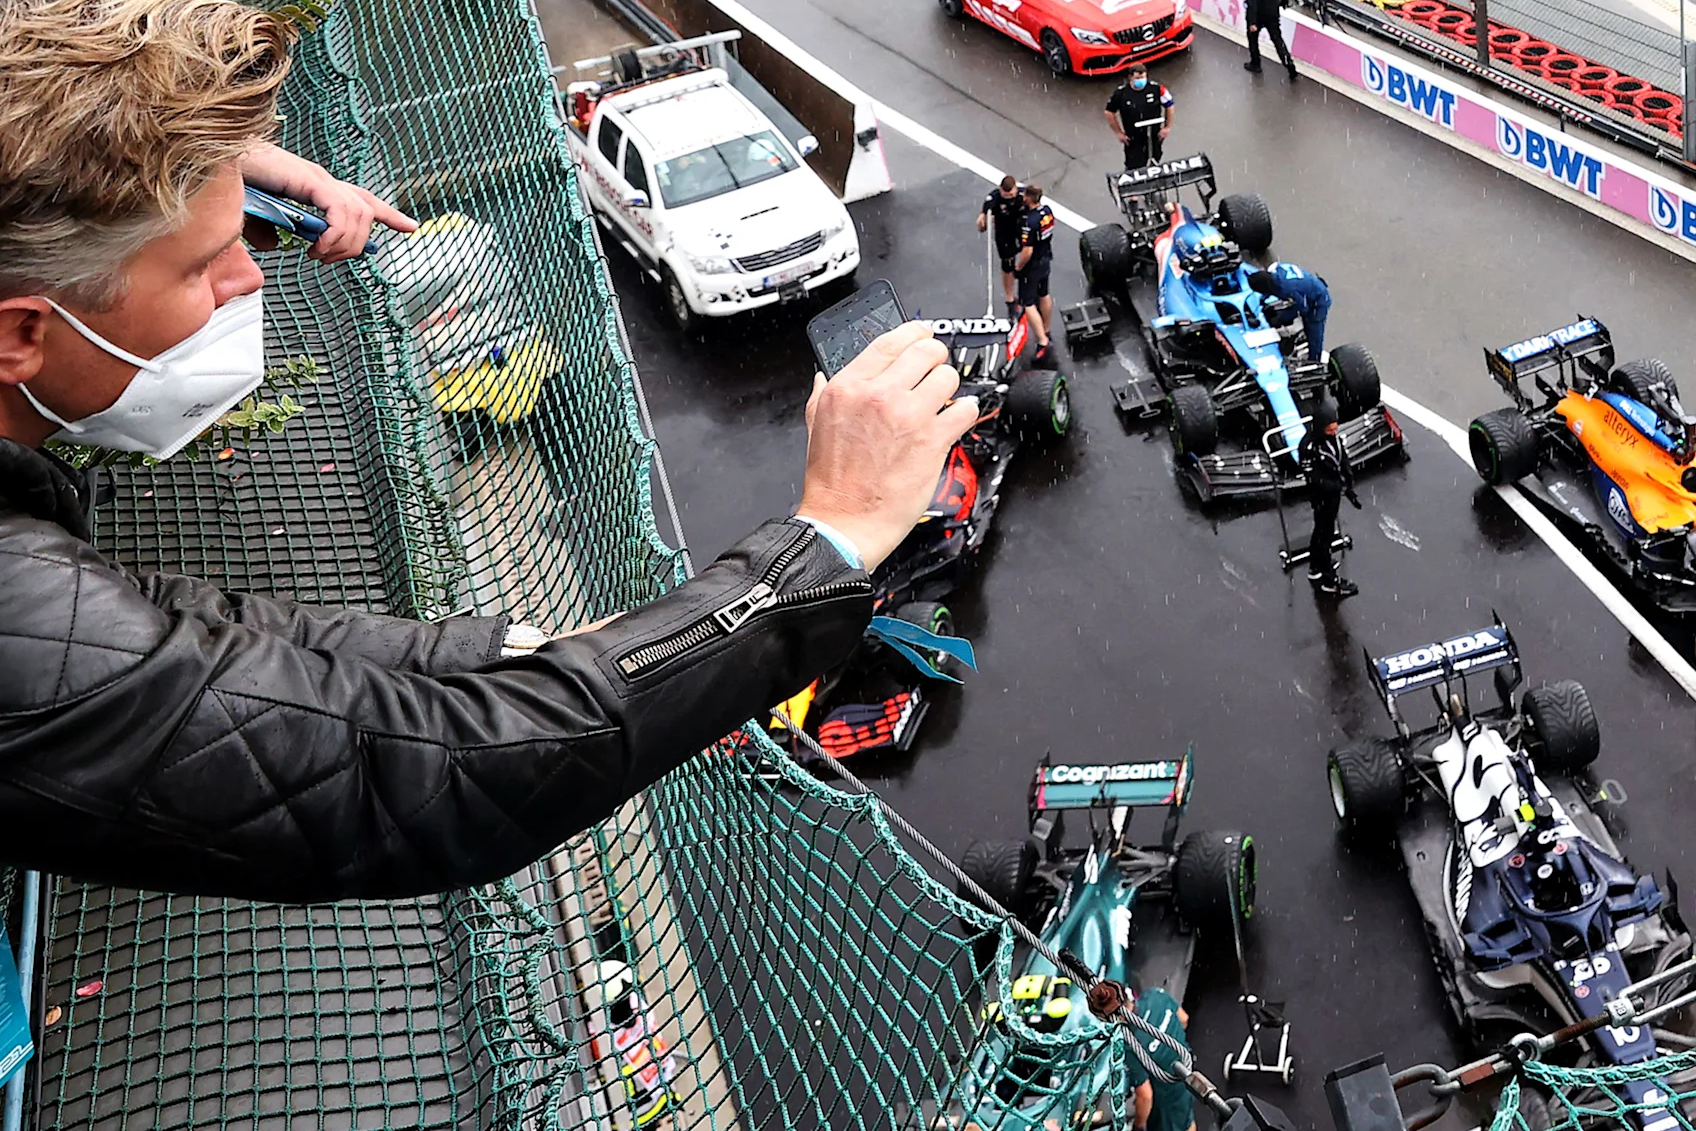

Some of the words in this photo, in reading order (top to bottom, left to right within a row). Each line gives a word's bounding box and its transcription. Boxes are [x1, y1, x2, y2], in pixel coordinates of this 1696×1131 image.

[1387, 64, 1456, 127] BWT
[1118, 155, 1203, 185] ALPINE
[1525, 128, 1603, 195] BWT
[1603, 409, 1639, 449] alteryx
[1385, 630, 1501, 675] HONDA
[1051, 760, 1167, 785] Cognizant
